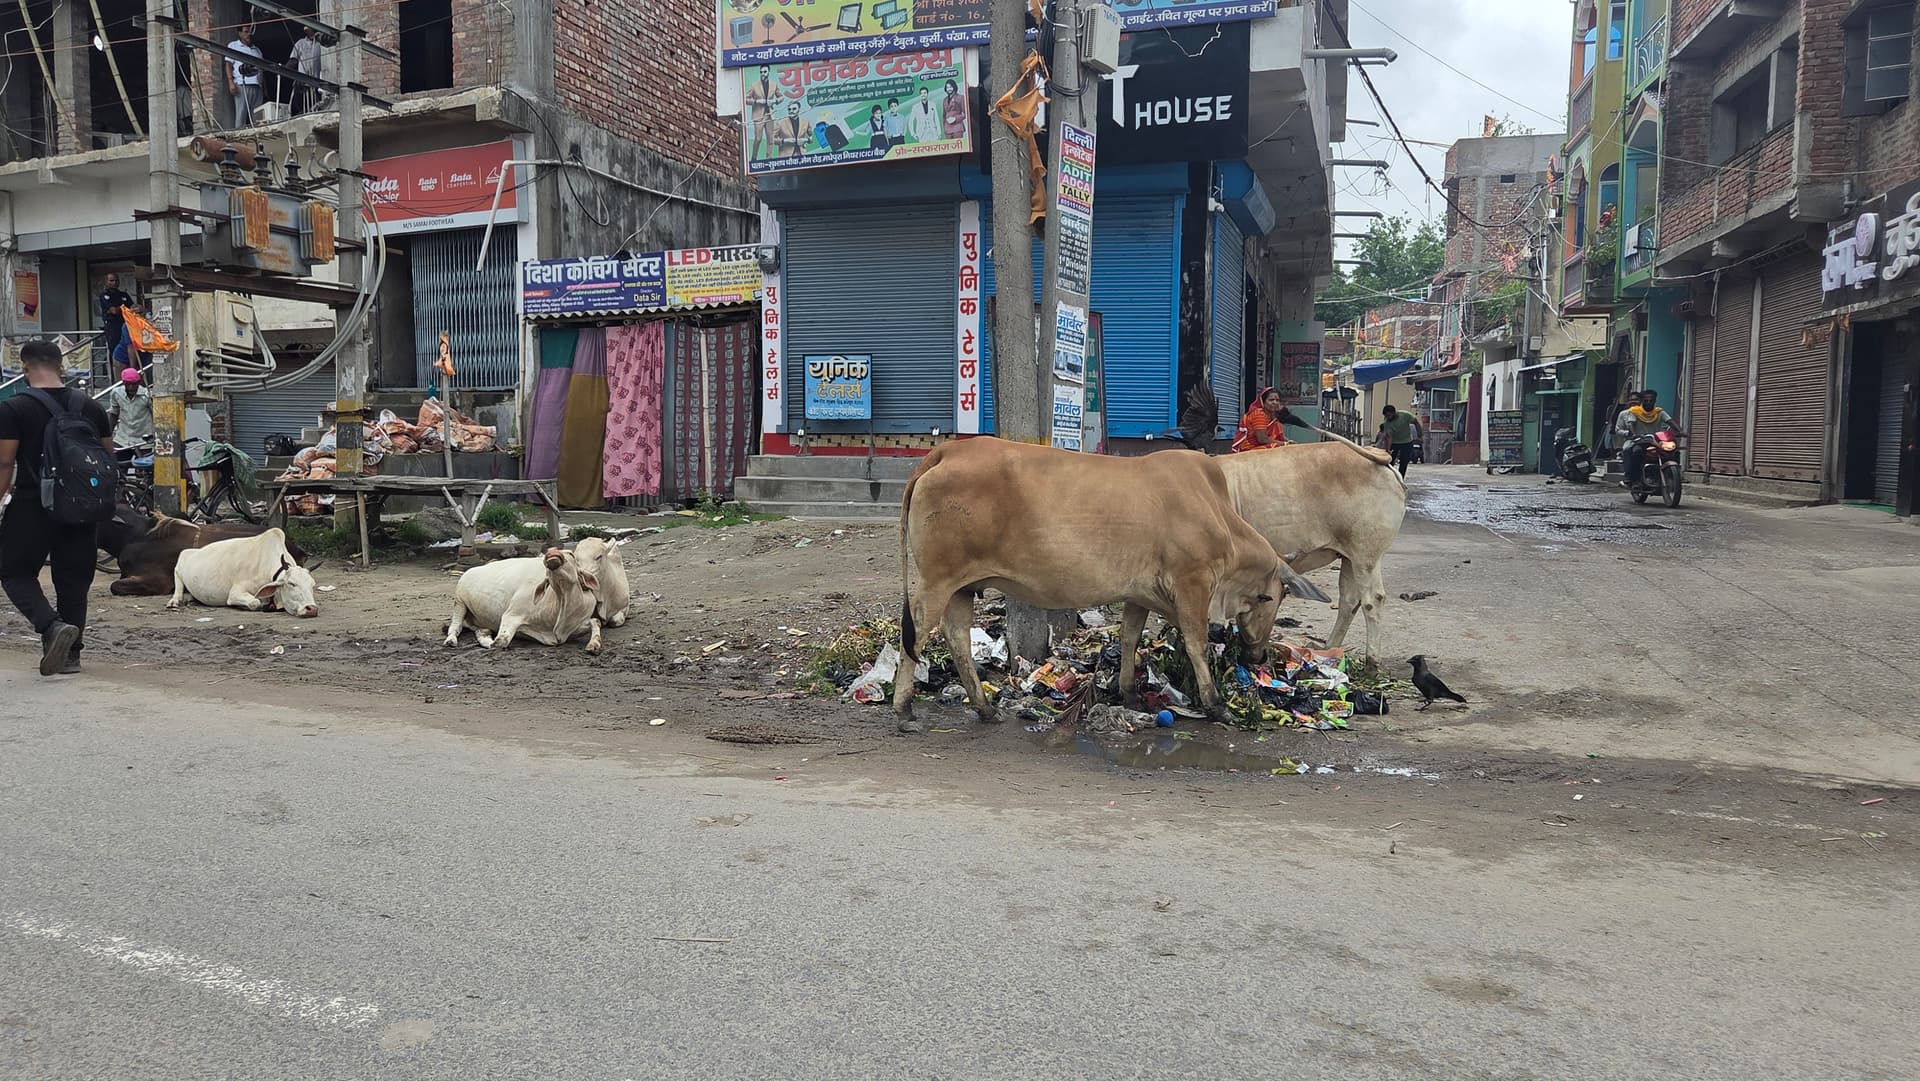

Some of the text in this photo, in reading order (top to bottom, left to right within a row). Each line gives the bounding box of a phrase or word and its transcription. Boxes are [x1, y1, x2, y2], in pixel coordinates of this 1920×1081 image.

[1183, 9, 1206, 23] मूल्य
[1209, 9, 1222, 17] पर
[1224, 5, 1247, 17] प्राप्त
[756, 47, 773, 59] यहाँ
[791, 45, 814, 56] पंडाल
[815, 43, 826, 53] के
[827, 41, 846, 53] सभी
[847, 40, 867, 54] वस्तु
[1135, 95, 1233, 130] HOUSE
[1064, 126, 1093, 150] दिल्ली
[450, 172, 472, 183] Bata
[1062, 164, 1091, 182] ADIT
[1062, 174, 1090, 193] ADCA
[1061, 184, 1090, 202] TALLY
[667, 248, 711, 266] LED
[524, 252, 662, 285] दिशा कोचिंग सेंटर
[633, 293, 649, 302] Data
[651, 292, 661, 301] Sir
[808, 355, 868, 382] यूनिक
